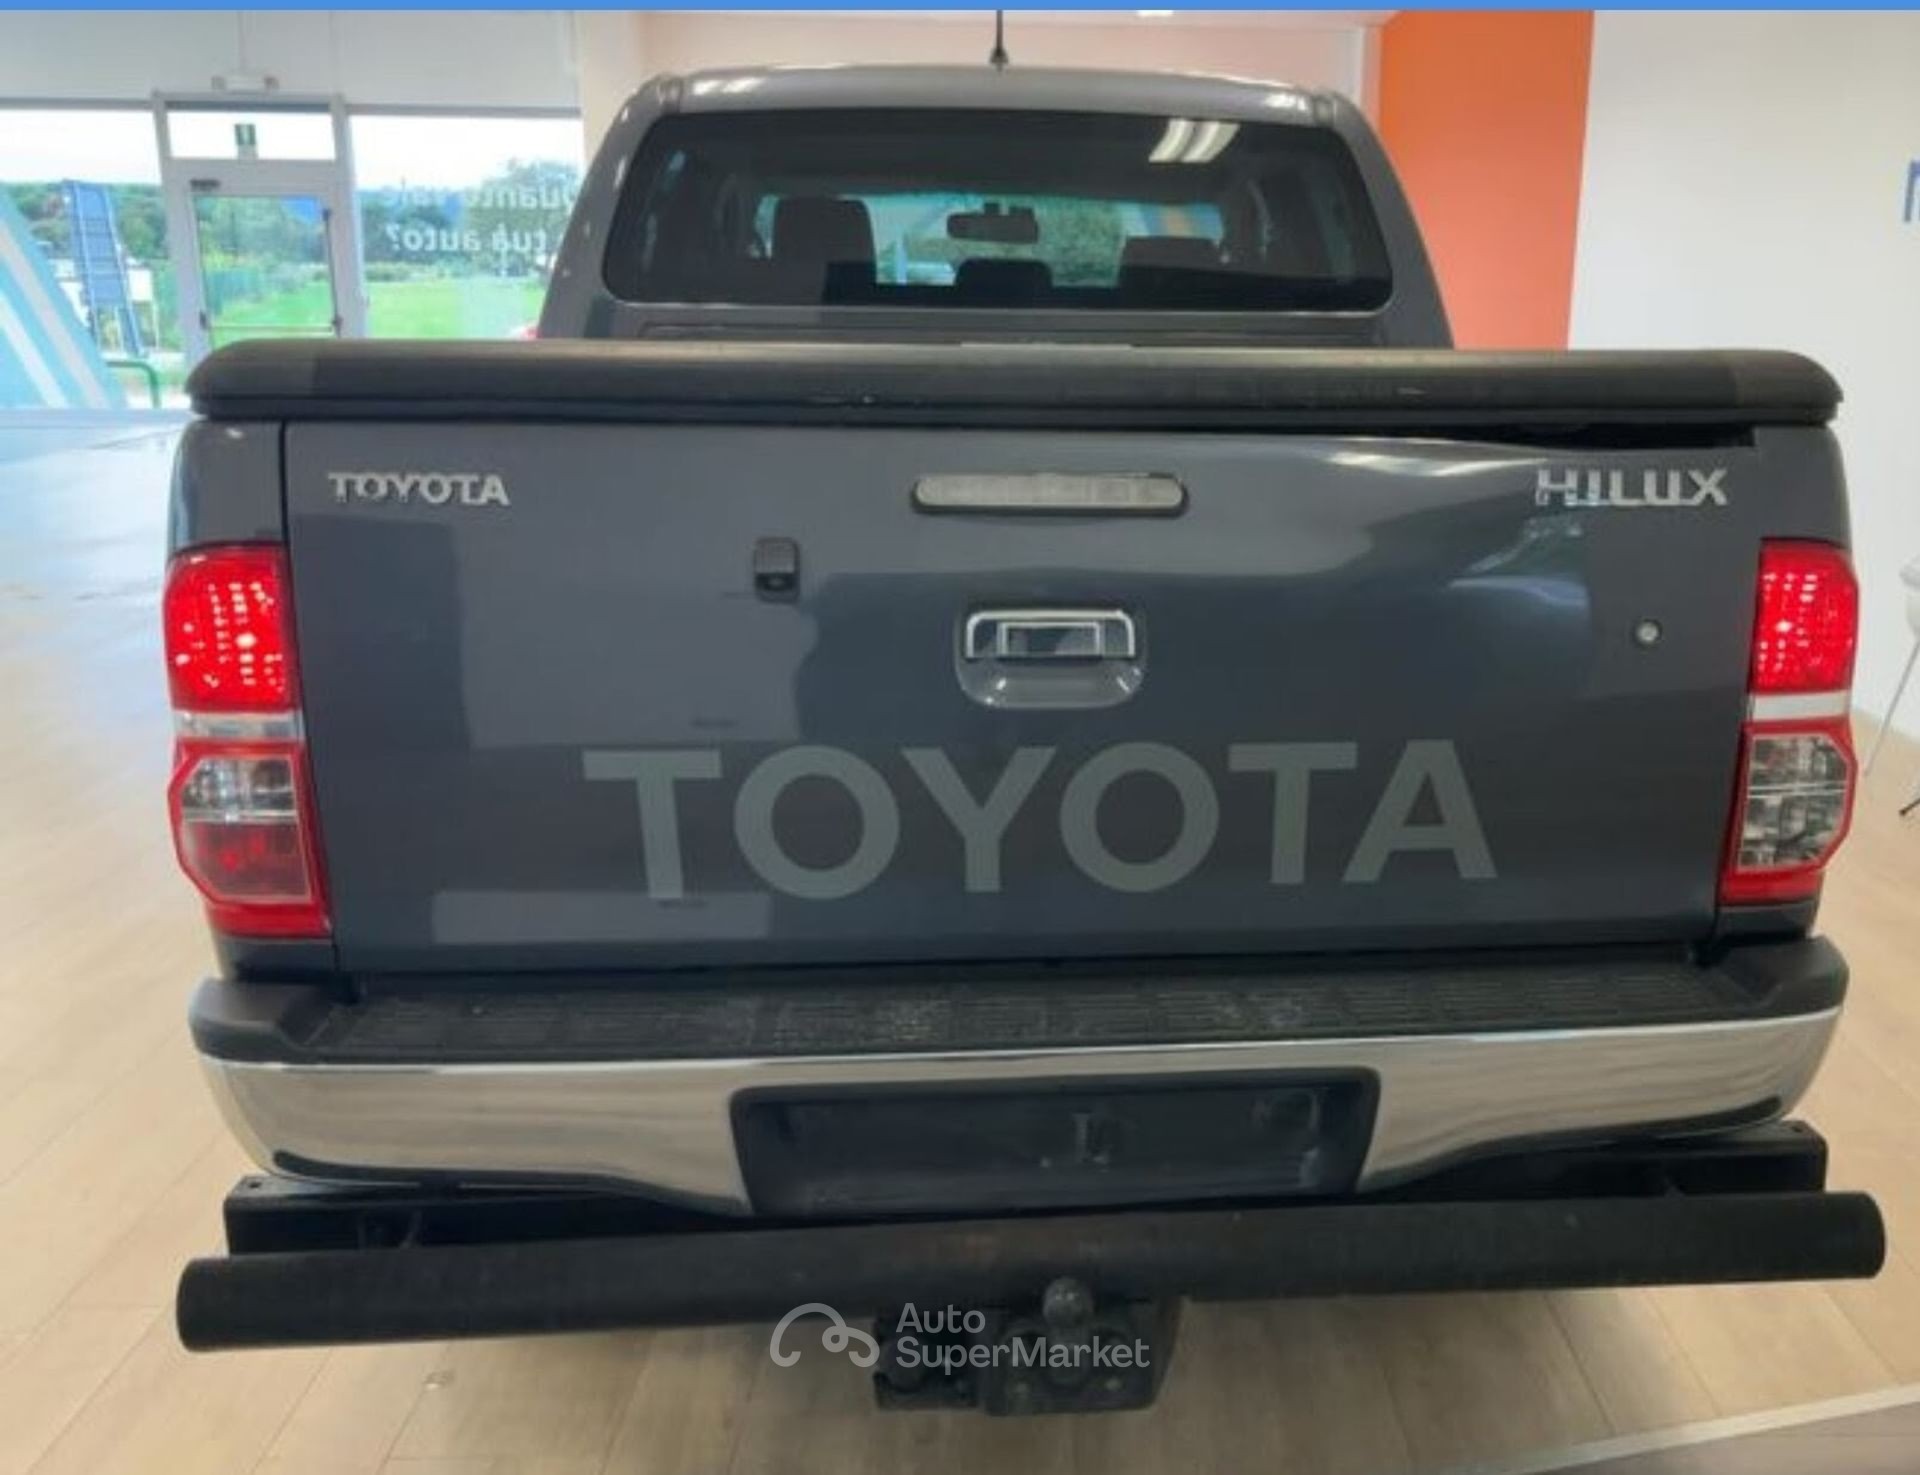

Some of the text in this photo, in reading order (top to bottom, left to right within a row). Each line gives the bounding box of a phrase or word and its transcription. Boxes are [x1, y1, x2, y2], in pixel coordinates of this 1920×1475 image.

[327, 471, 512, 506] TOYOTA
[1535, 468, 1729, 507] HILUX
[583, 739, 1498, 900] TOYOTA
